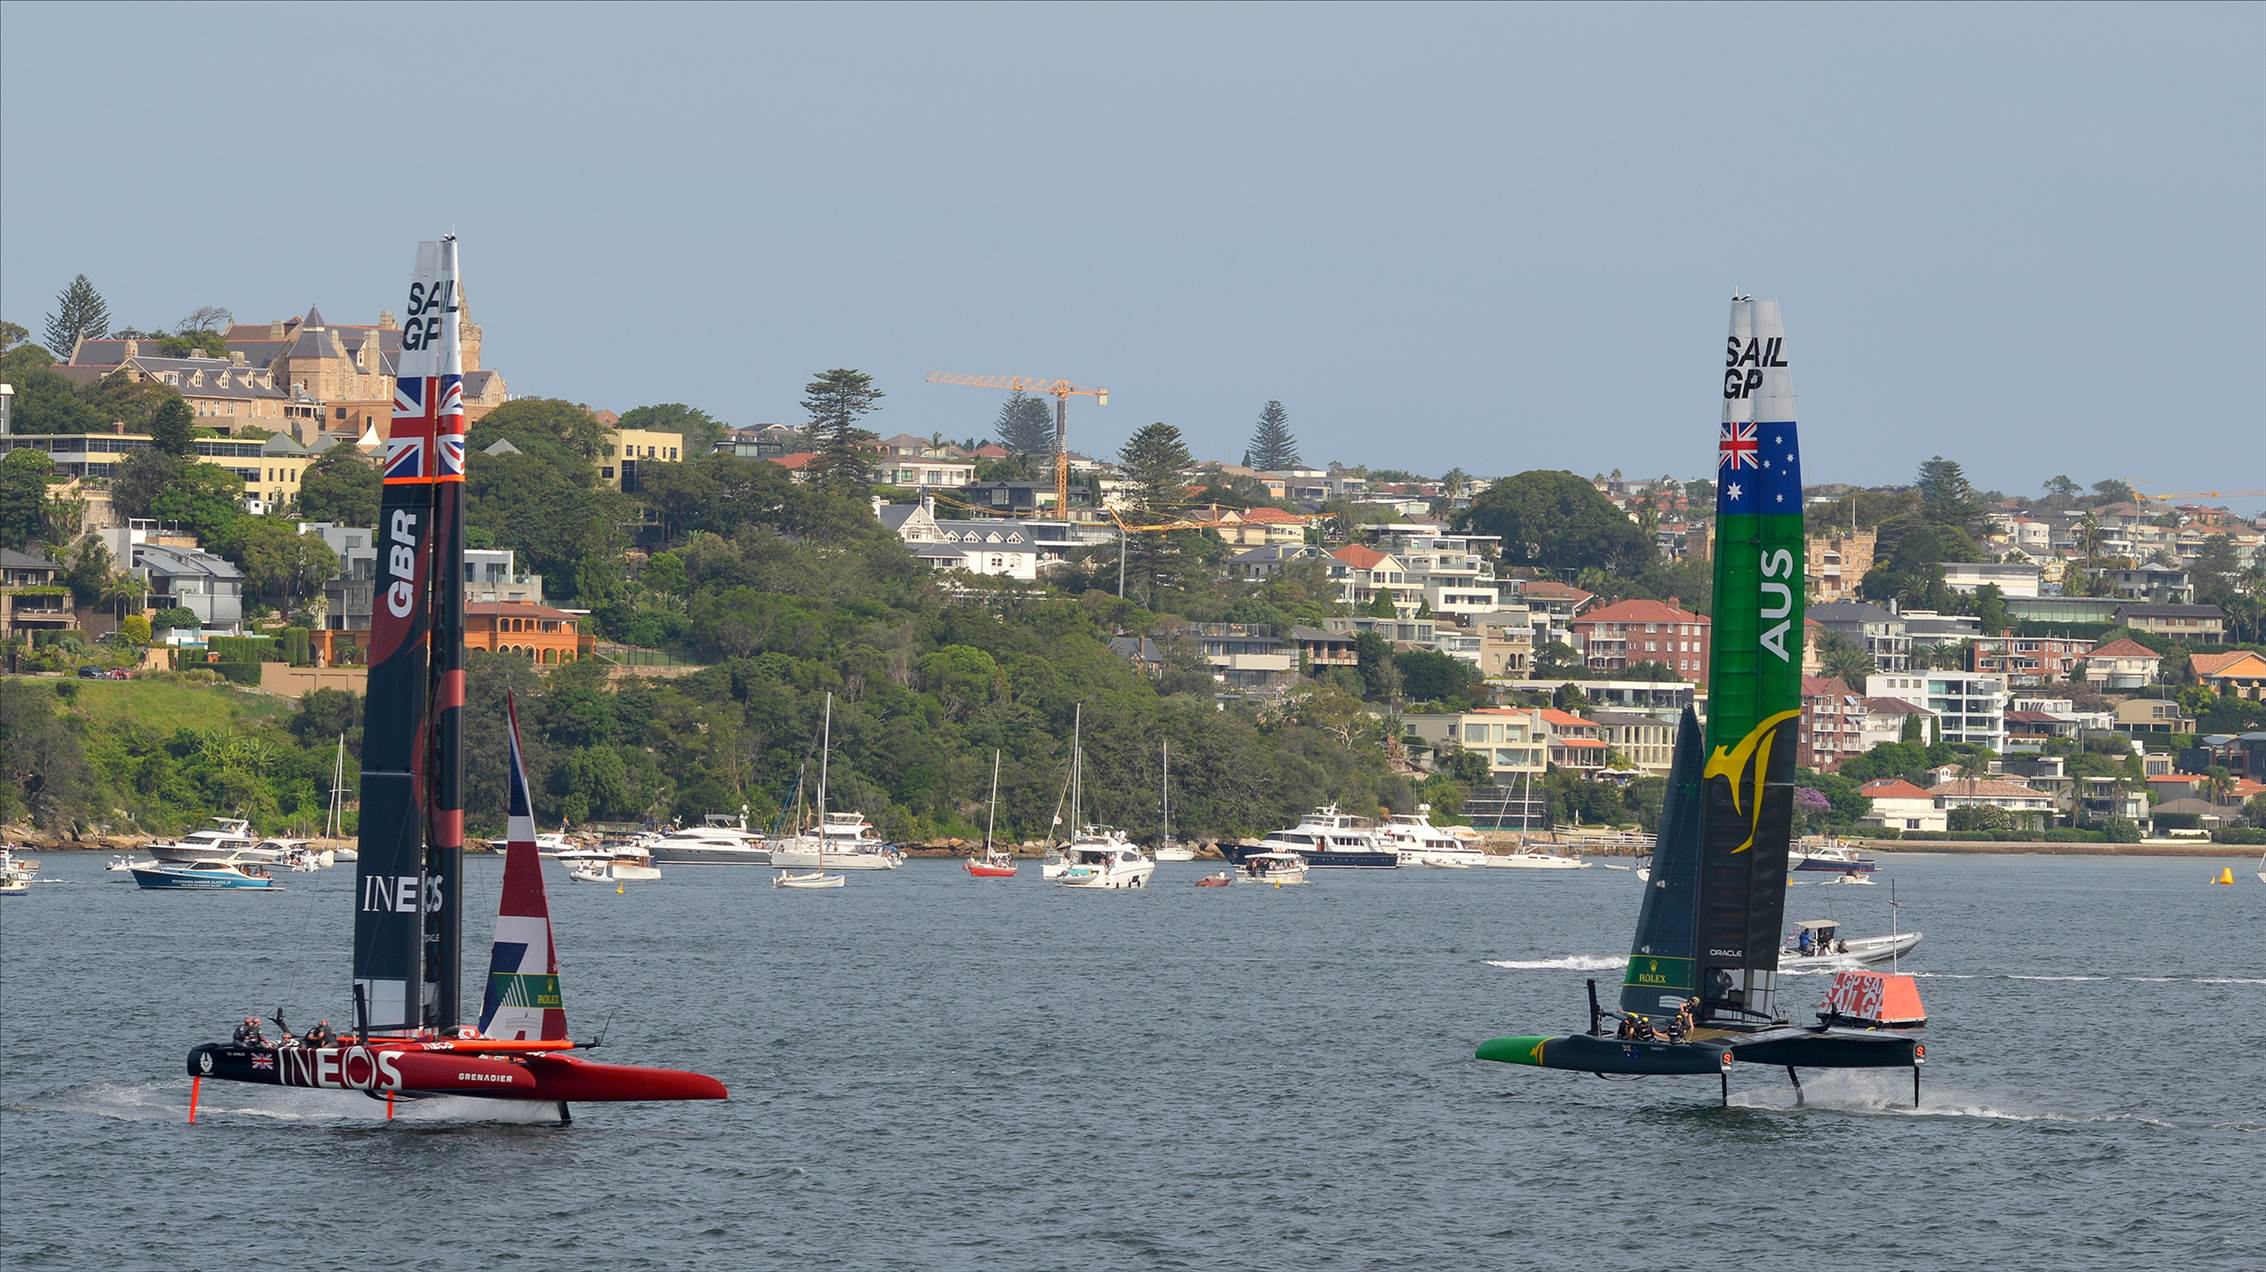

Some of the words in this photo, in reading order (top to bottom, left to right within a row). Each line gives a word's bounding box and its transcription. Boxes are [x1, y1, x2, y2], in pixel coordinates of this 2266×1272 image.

[407, 280, 459, 316] SAIL
[1725, 337, 1788, 368] SAIL
[1723, 369, 1763, 400] GP
[387, 509, 417, 618] GBR
[1760, 548, 1793, 663] AUS
[362, 875, 444, 912] INEOS
[1709, 948, 1742, 957] ORACLE
[1639, 973, 1666, 984] ROLEX
[537, 994, 561, 1005] ROLEX
[278, 1044, 406, 1091] INEOS
[458, 1072, 513, 1083] GRENADIER
